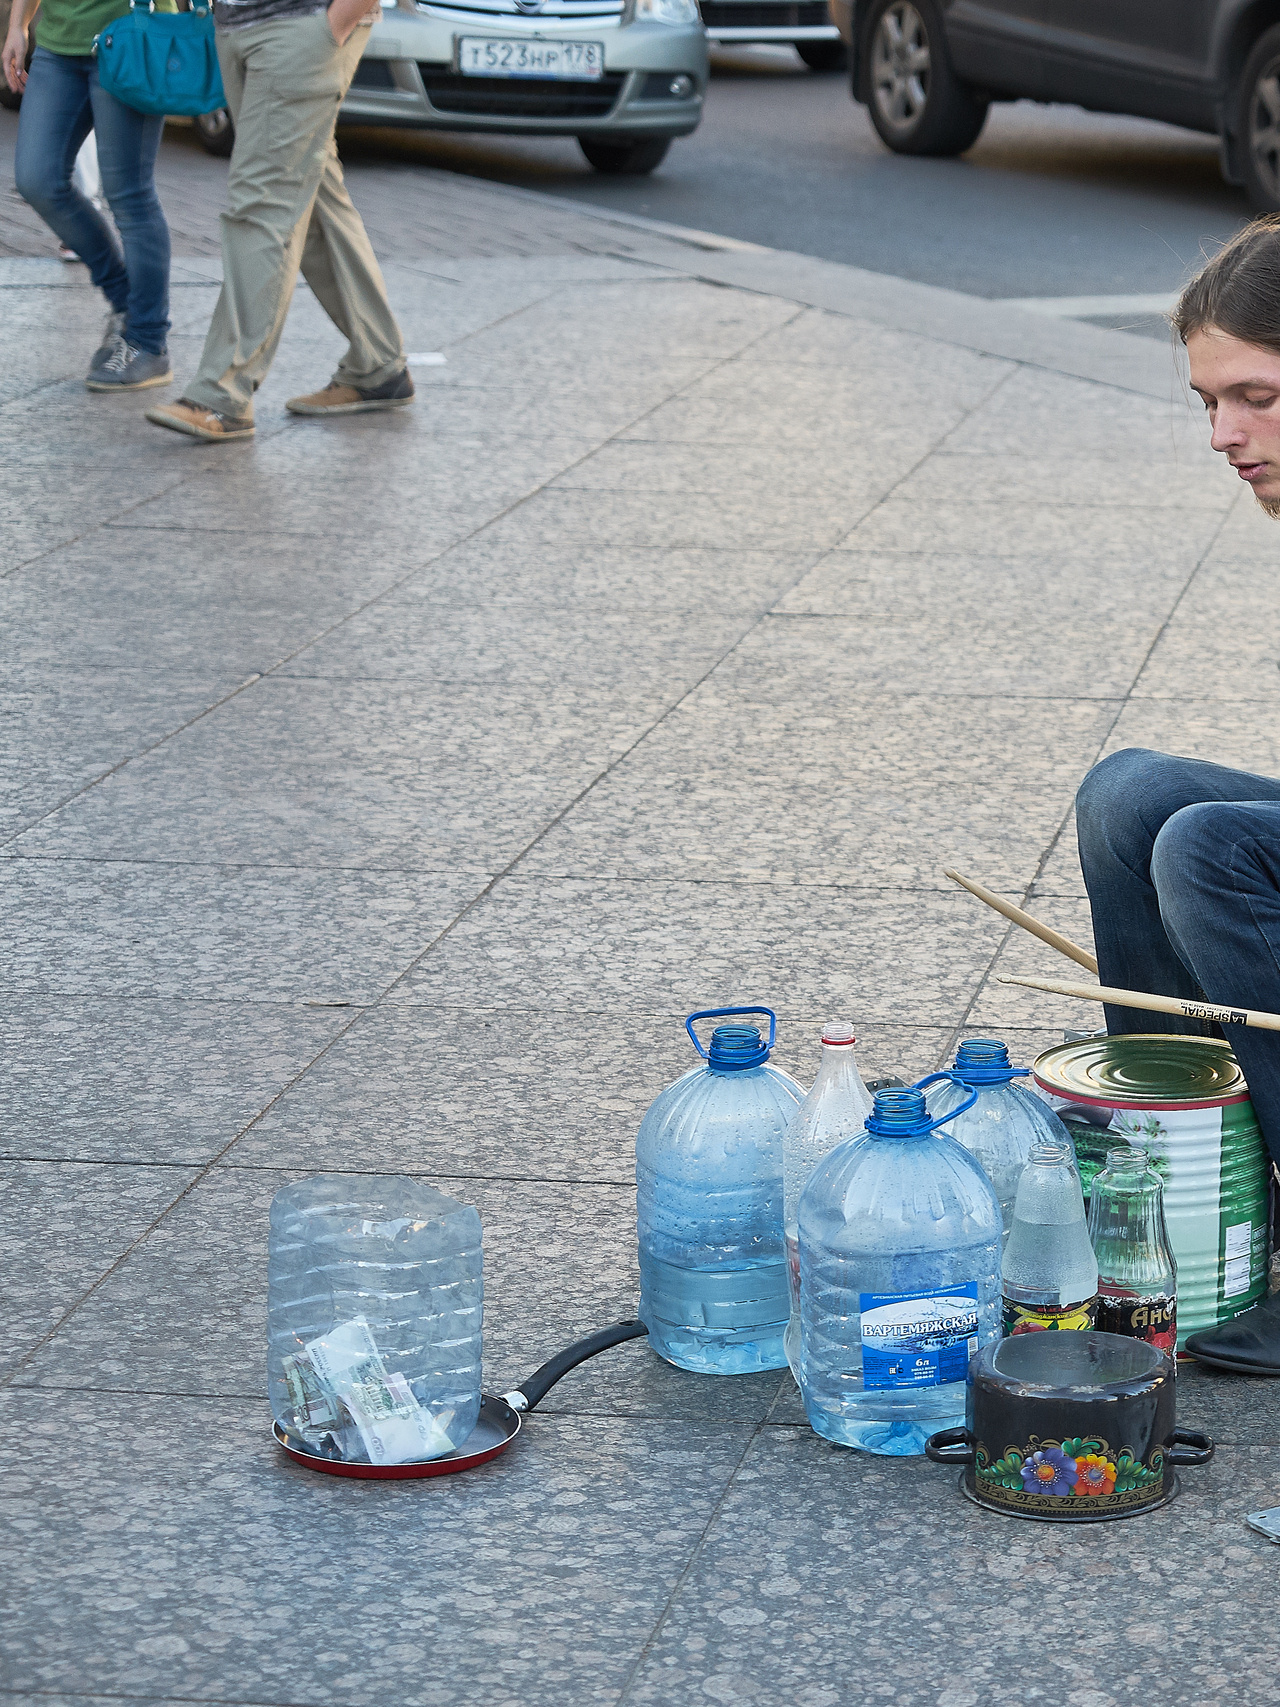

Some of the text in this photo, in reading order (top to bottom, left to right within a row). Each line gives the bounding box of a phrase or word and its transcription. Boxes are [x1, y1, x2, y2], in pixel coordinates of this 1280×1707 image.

[1181, 1005, 1246, 1025] LA SPECIAL
[862, 1311, 978, 1337] ВАРТЕМЯЖСКАЯ
